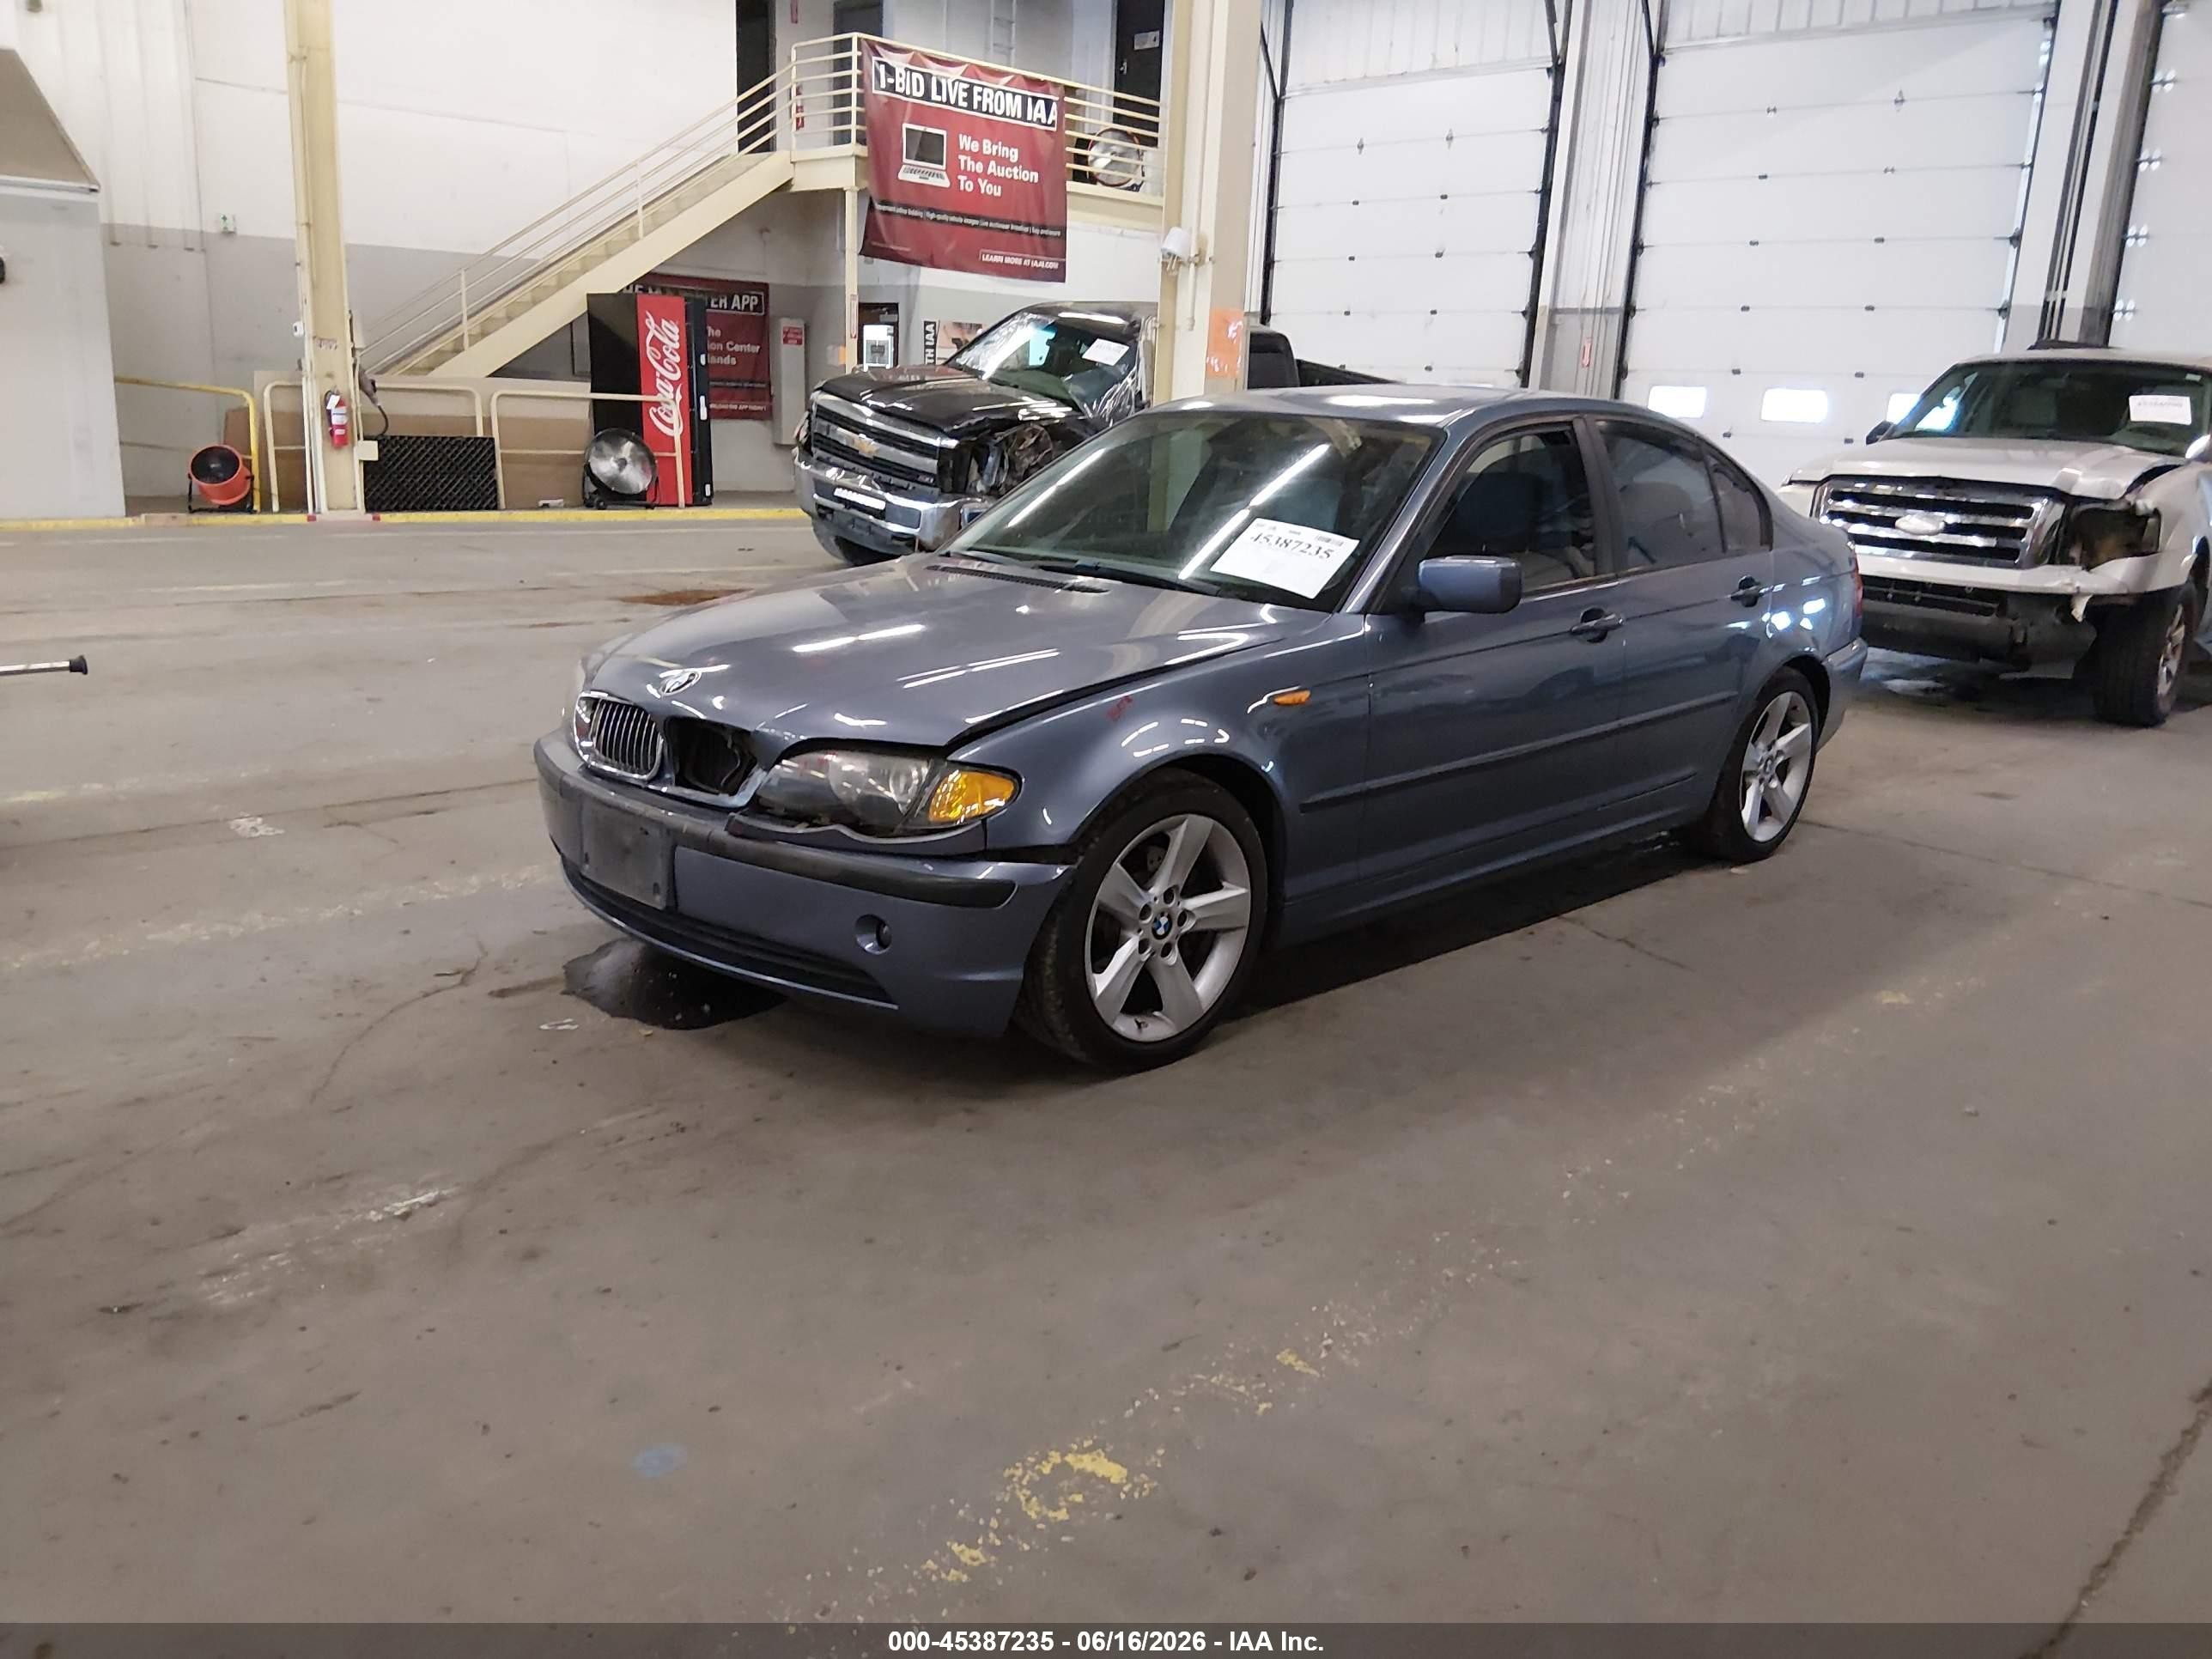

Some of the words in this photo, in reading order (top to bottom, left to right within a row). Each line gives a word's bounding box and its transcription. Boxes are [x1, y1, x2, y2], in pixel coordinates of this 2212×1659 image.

[931, 76, 968, 107] LIVE
[972, 87, 1022, 118] FROM
[1027, 97, 1056, 125] IAA
[958, 133, 979, 152] We
[982, 138, 1018, 162] Bring
[957, 155, 983, 173] The
[987, 160, 1039, 183] Auction
[957, 174, 973, 191] To
[977, 178, 1001, 197] You
[731, 294, 758, 311] APP
[726, 341, 761, 353] Center
[646, 310, 684, 436] Coca-Cola
